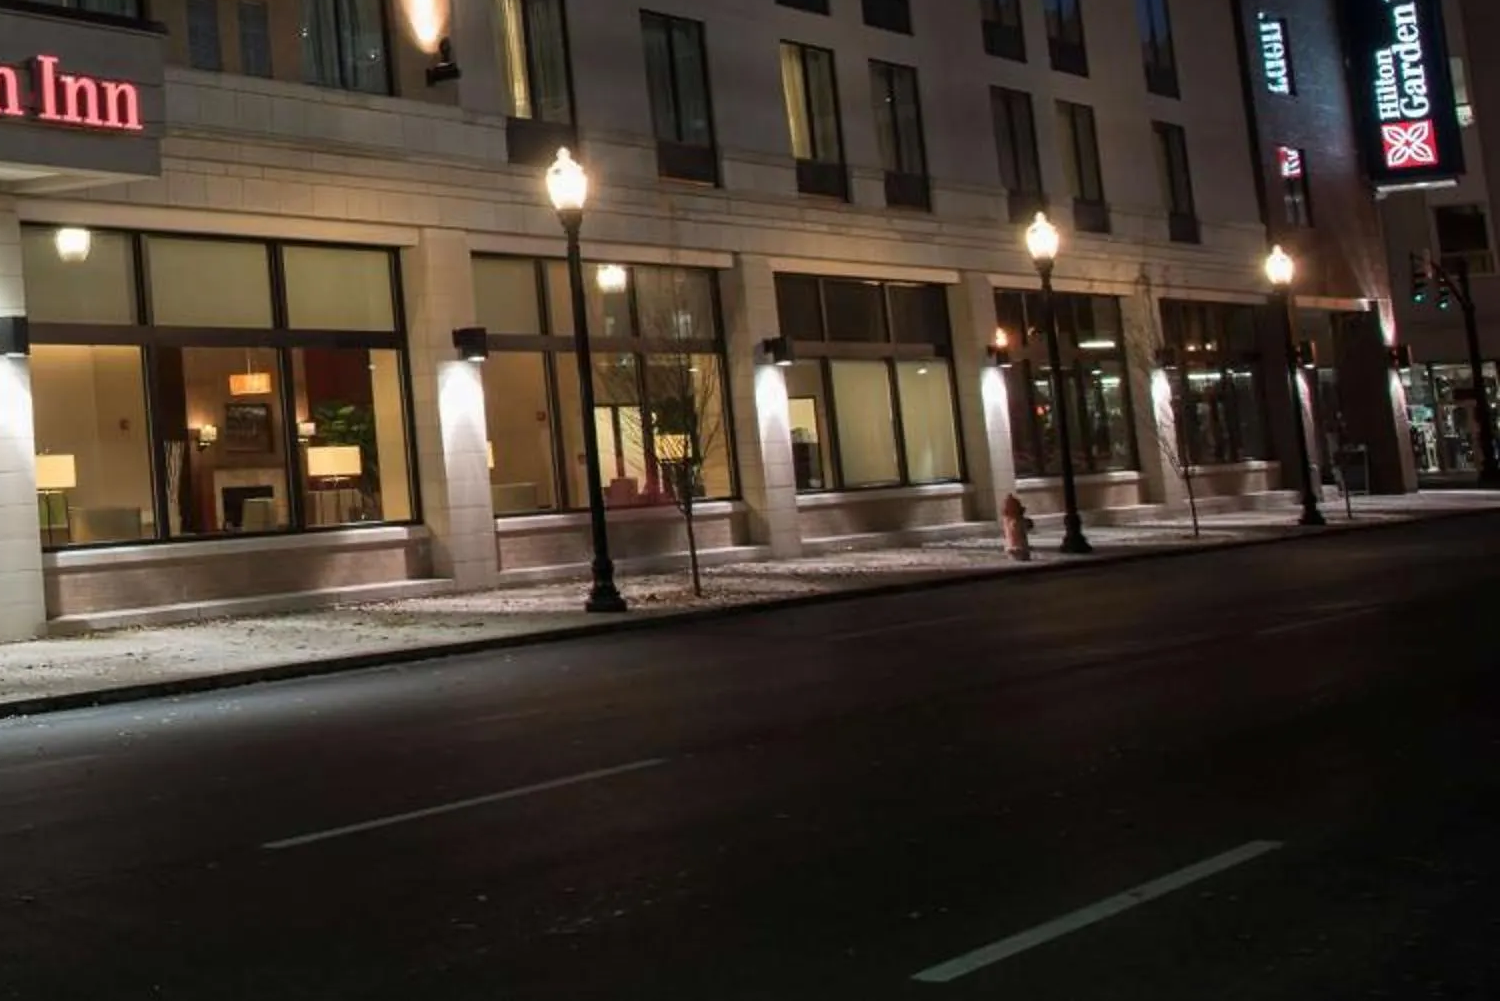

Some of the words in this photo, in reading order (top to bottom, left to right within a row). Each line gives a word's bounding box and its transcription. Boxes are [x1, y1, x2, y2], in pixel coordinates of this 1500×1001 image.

[38, 54, 144, 131] Inn
[1373, 48, 1401, 120] Hilton
[1390, 1, 1430, 119] Garden
